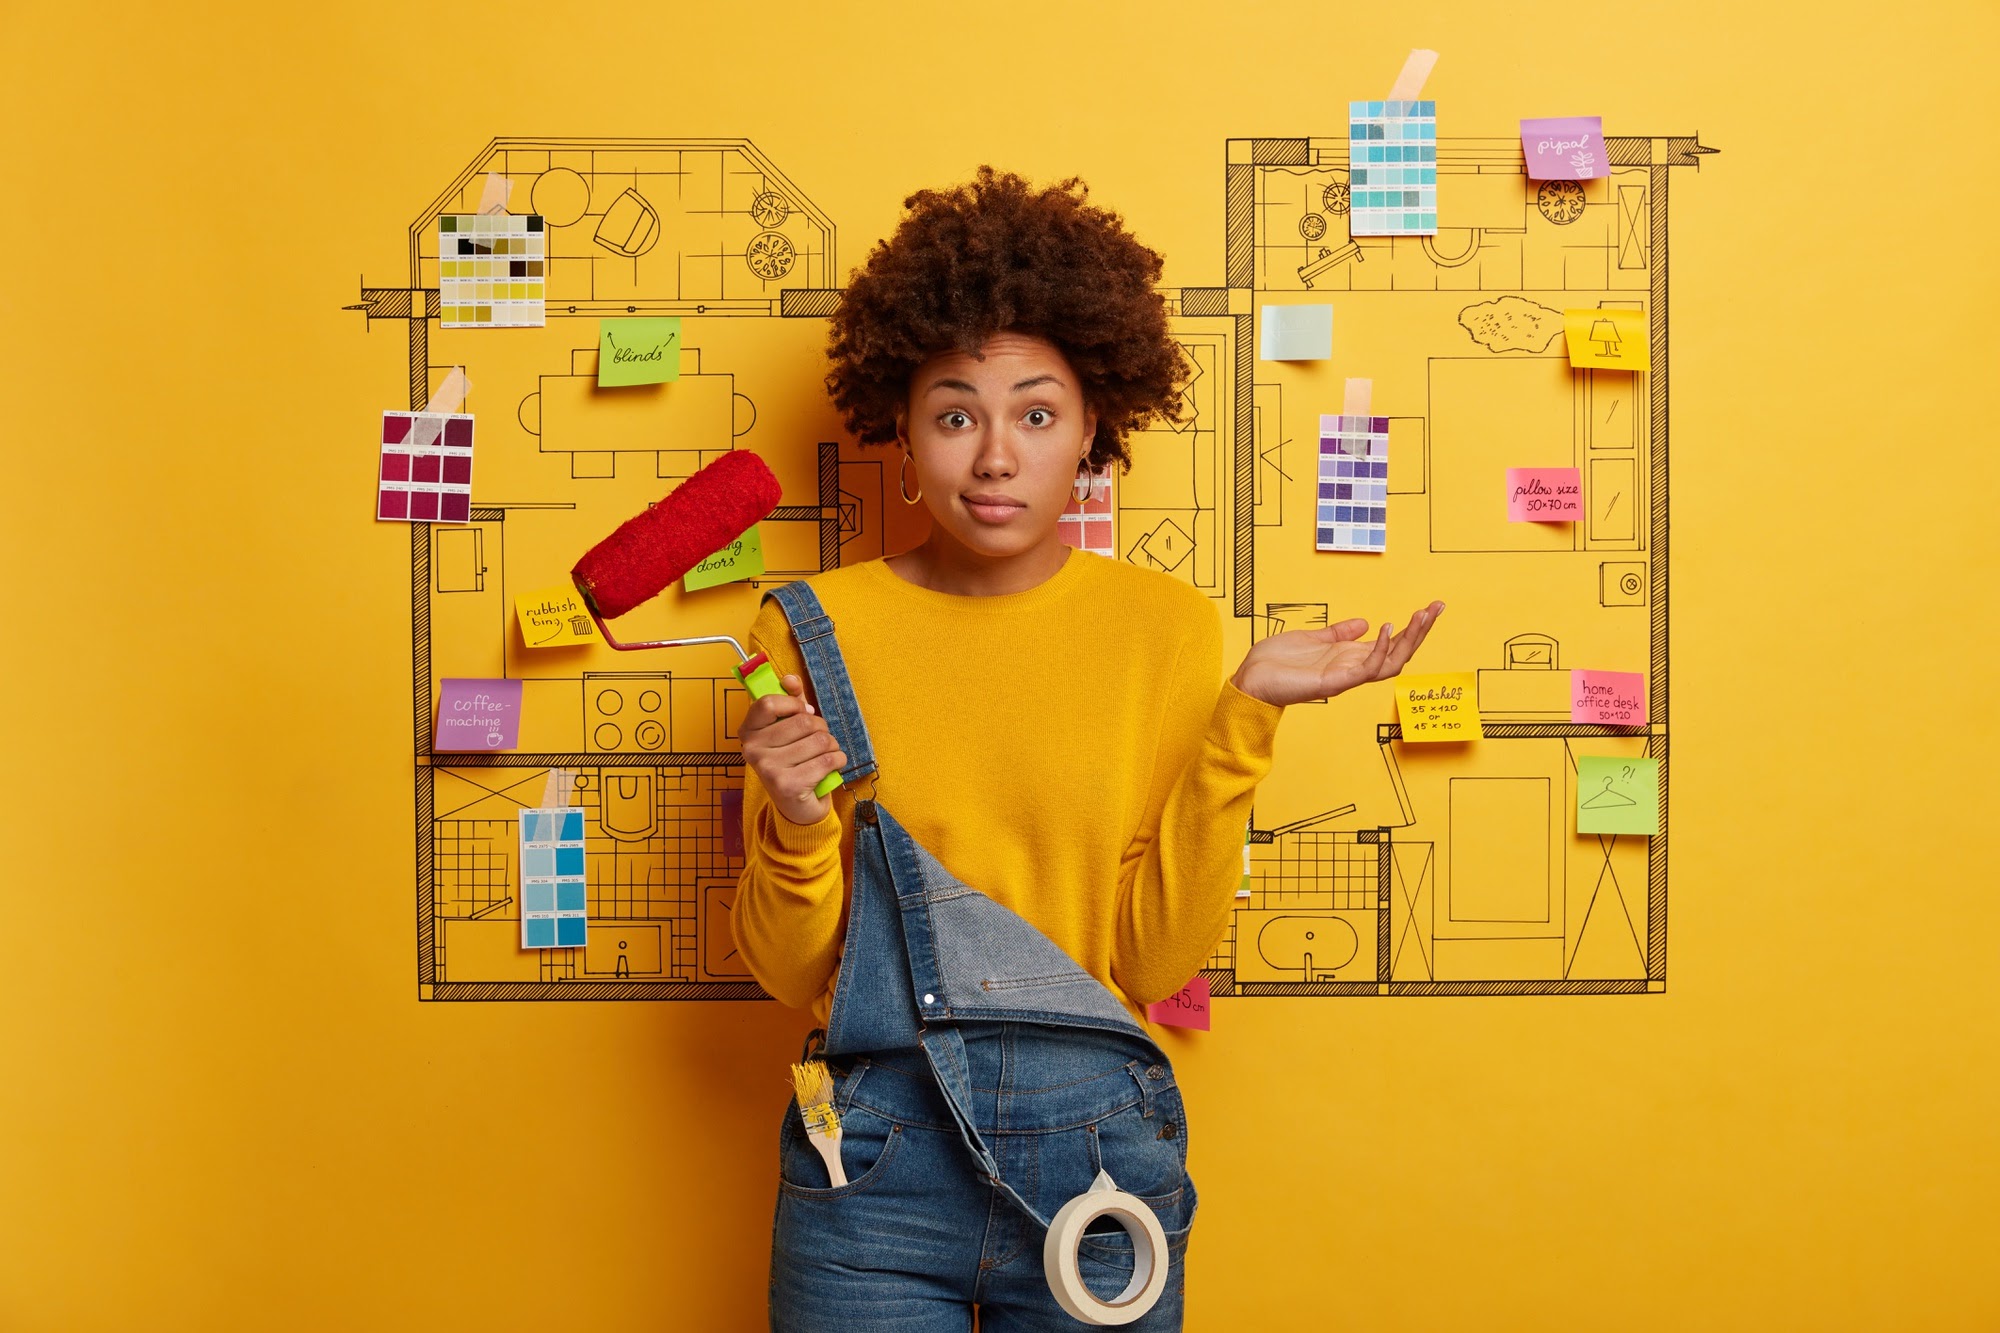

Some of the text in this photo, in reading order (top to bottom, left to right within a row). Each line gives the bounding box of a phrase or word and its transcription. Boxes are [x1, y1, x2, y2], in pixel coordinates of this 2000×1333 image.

[1537, 134, 1589, 155] pipal
[613, 345, 662, 364] blinds
[1512, 478, 1578, 503] pillow size
[1563, 502, 1577, 510] cm
[697, 557, 735, 573] doors
[526, 597, 577, 616] rubbish
[1409, 686, 1463, 702] bookshelf
[1582, 680, 1614, 695] home
[1577, 695, 1640, 710] office desk
[445, 714, 501, 727] machine
[1441, 722, 1462, 730] 130
